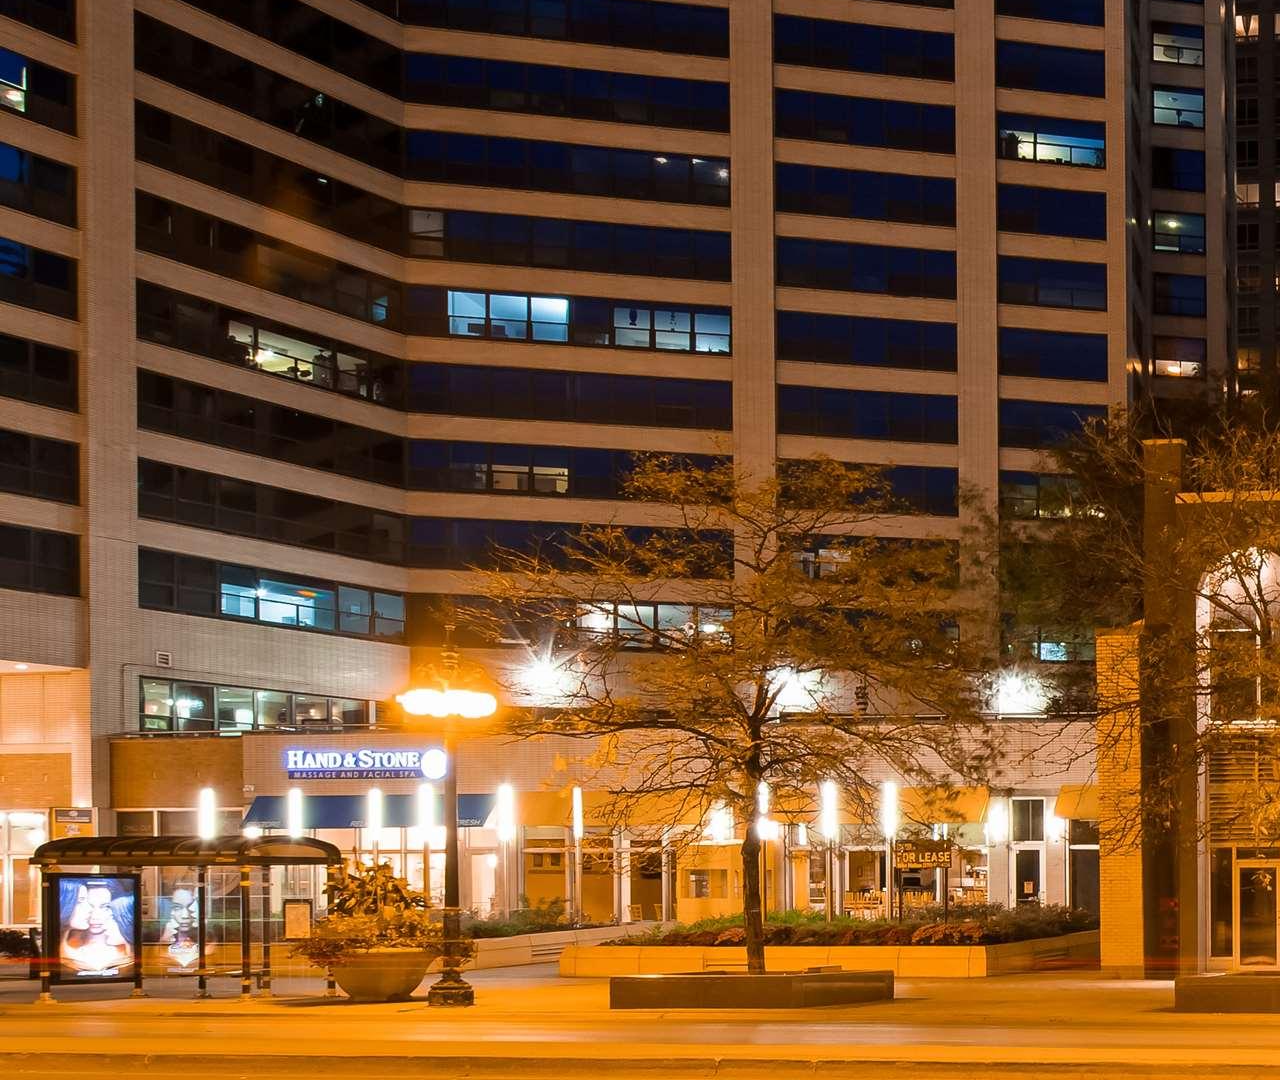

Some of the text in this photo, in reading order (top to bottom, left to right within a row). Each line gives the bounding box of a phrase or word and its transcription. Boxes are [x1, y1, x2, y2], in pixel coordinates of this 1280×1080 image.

[287, 749, 421, 769] HAND & STONE
[293, 770, 417, 778] MASSAGE AND FACIAL SPA
[896, 852, 950, 863] FOR LEASE
